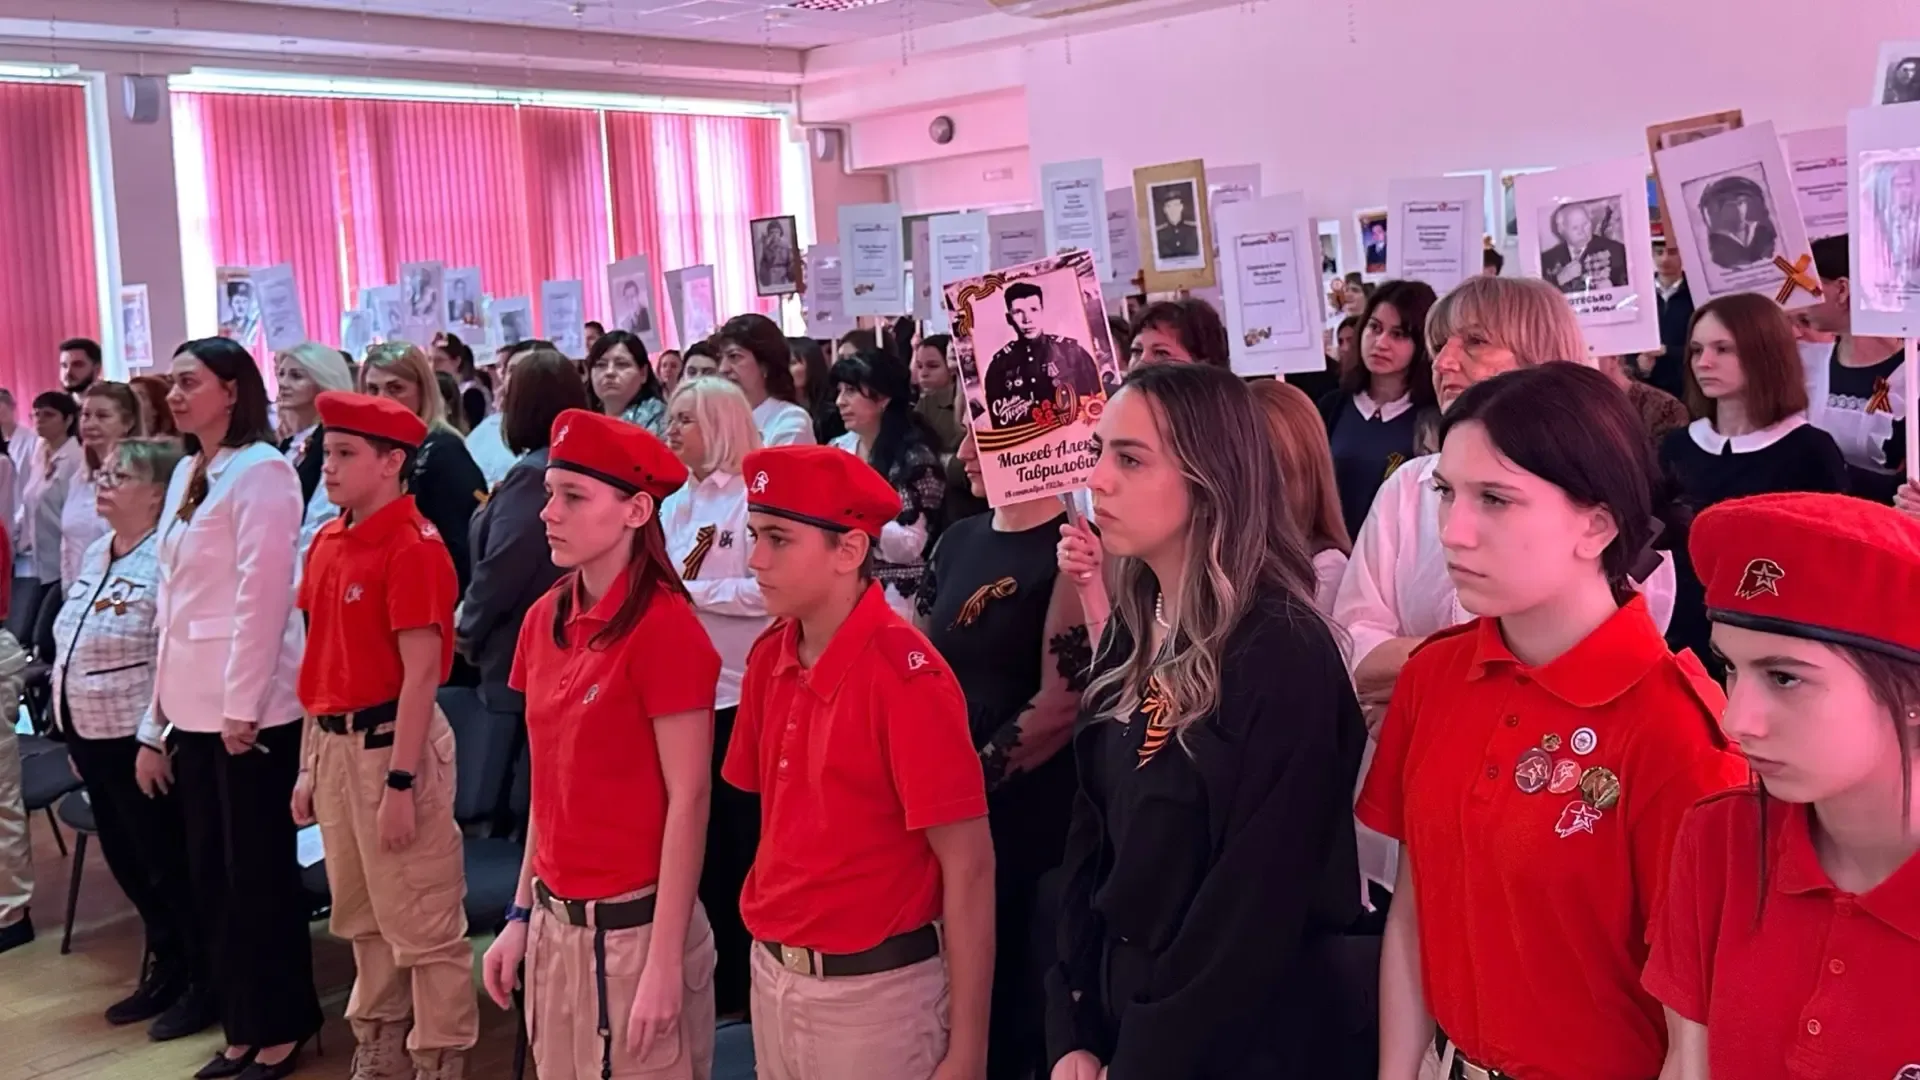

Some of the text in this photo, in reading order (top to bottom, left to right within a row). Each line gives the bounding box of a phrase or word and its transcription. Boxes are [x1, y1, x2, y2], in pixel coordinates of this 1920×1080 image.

[1568, 293, 1612, 305] ОТЕСЬКО
[997, 439, 1093, 469] Макеев Алек
[1016, 455, 1098, 483] Гаврилови
